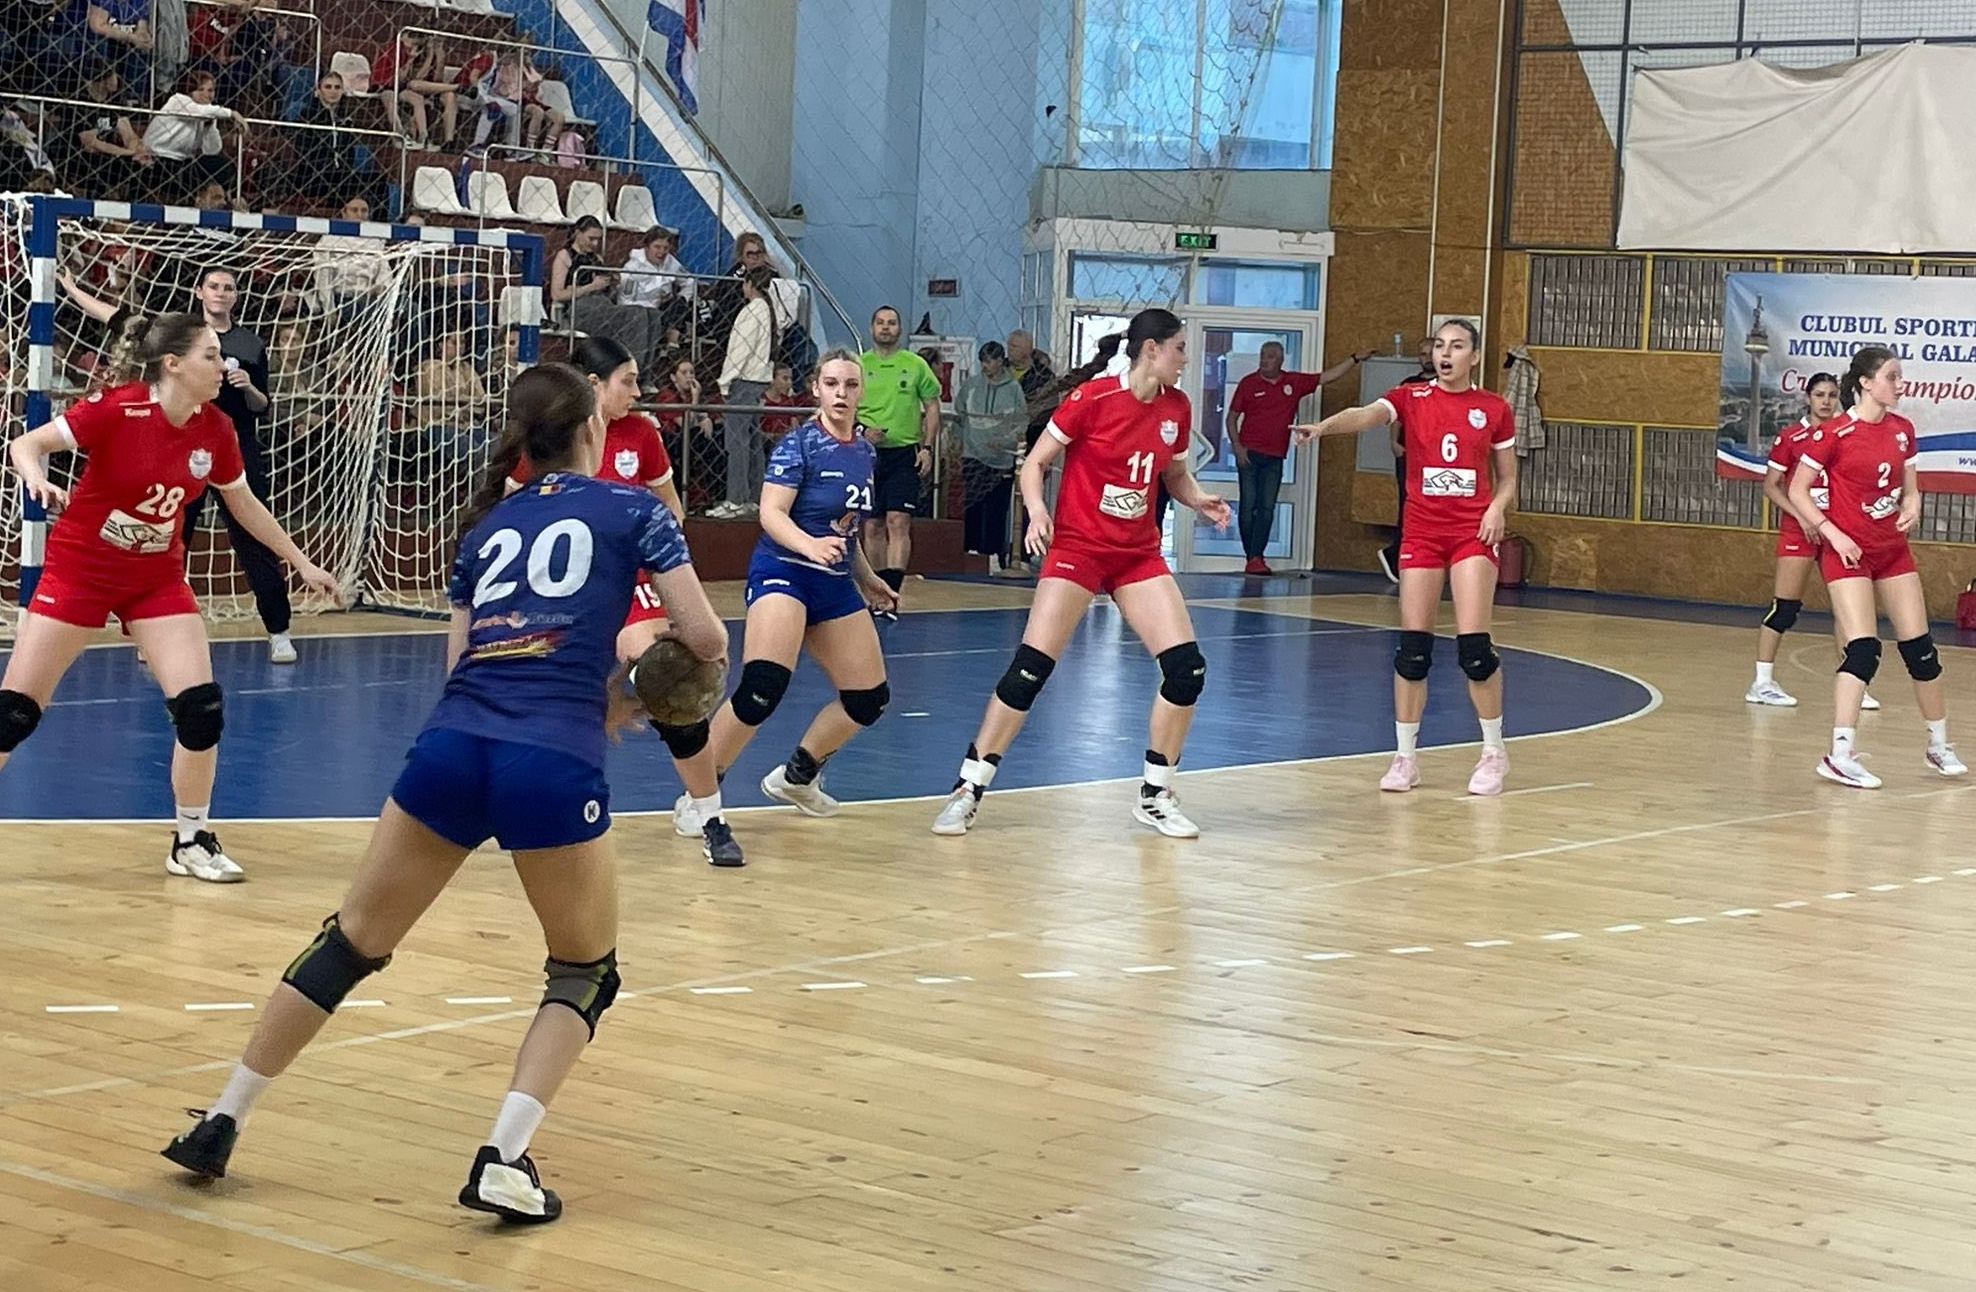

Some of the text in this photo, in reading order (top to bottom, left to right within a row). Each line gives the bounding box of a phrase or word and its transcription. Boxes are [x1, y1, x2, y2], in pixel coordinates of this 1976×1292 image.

[1180, 234, 1212, 248] EXIT
[1801, 314, 1887, 334] CLUBUL
[1789, 339, 1914, 360] MUNICAL
[1900, 376, 1976, 405] ampio
[1440, 432, 1459, 464] 6
[1126, 450, 1155, 484] 11
[1877, 462, 1892, 488] 2
[135, 482, 186, 519] 28
[845, 484, 873, 511] 21
[472, 518, 594, 610] 20
